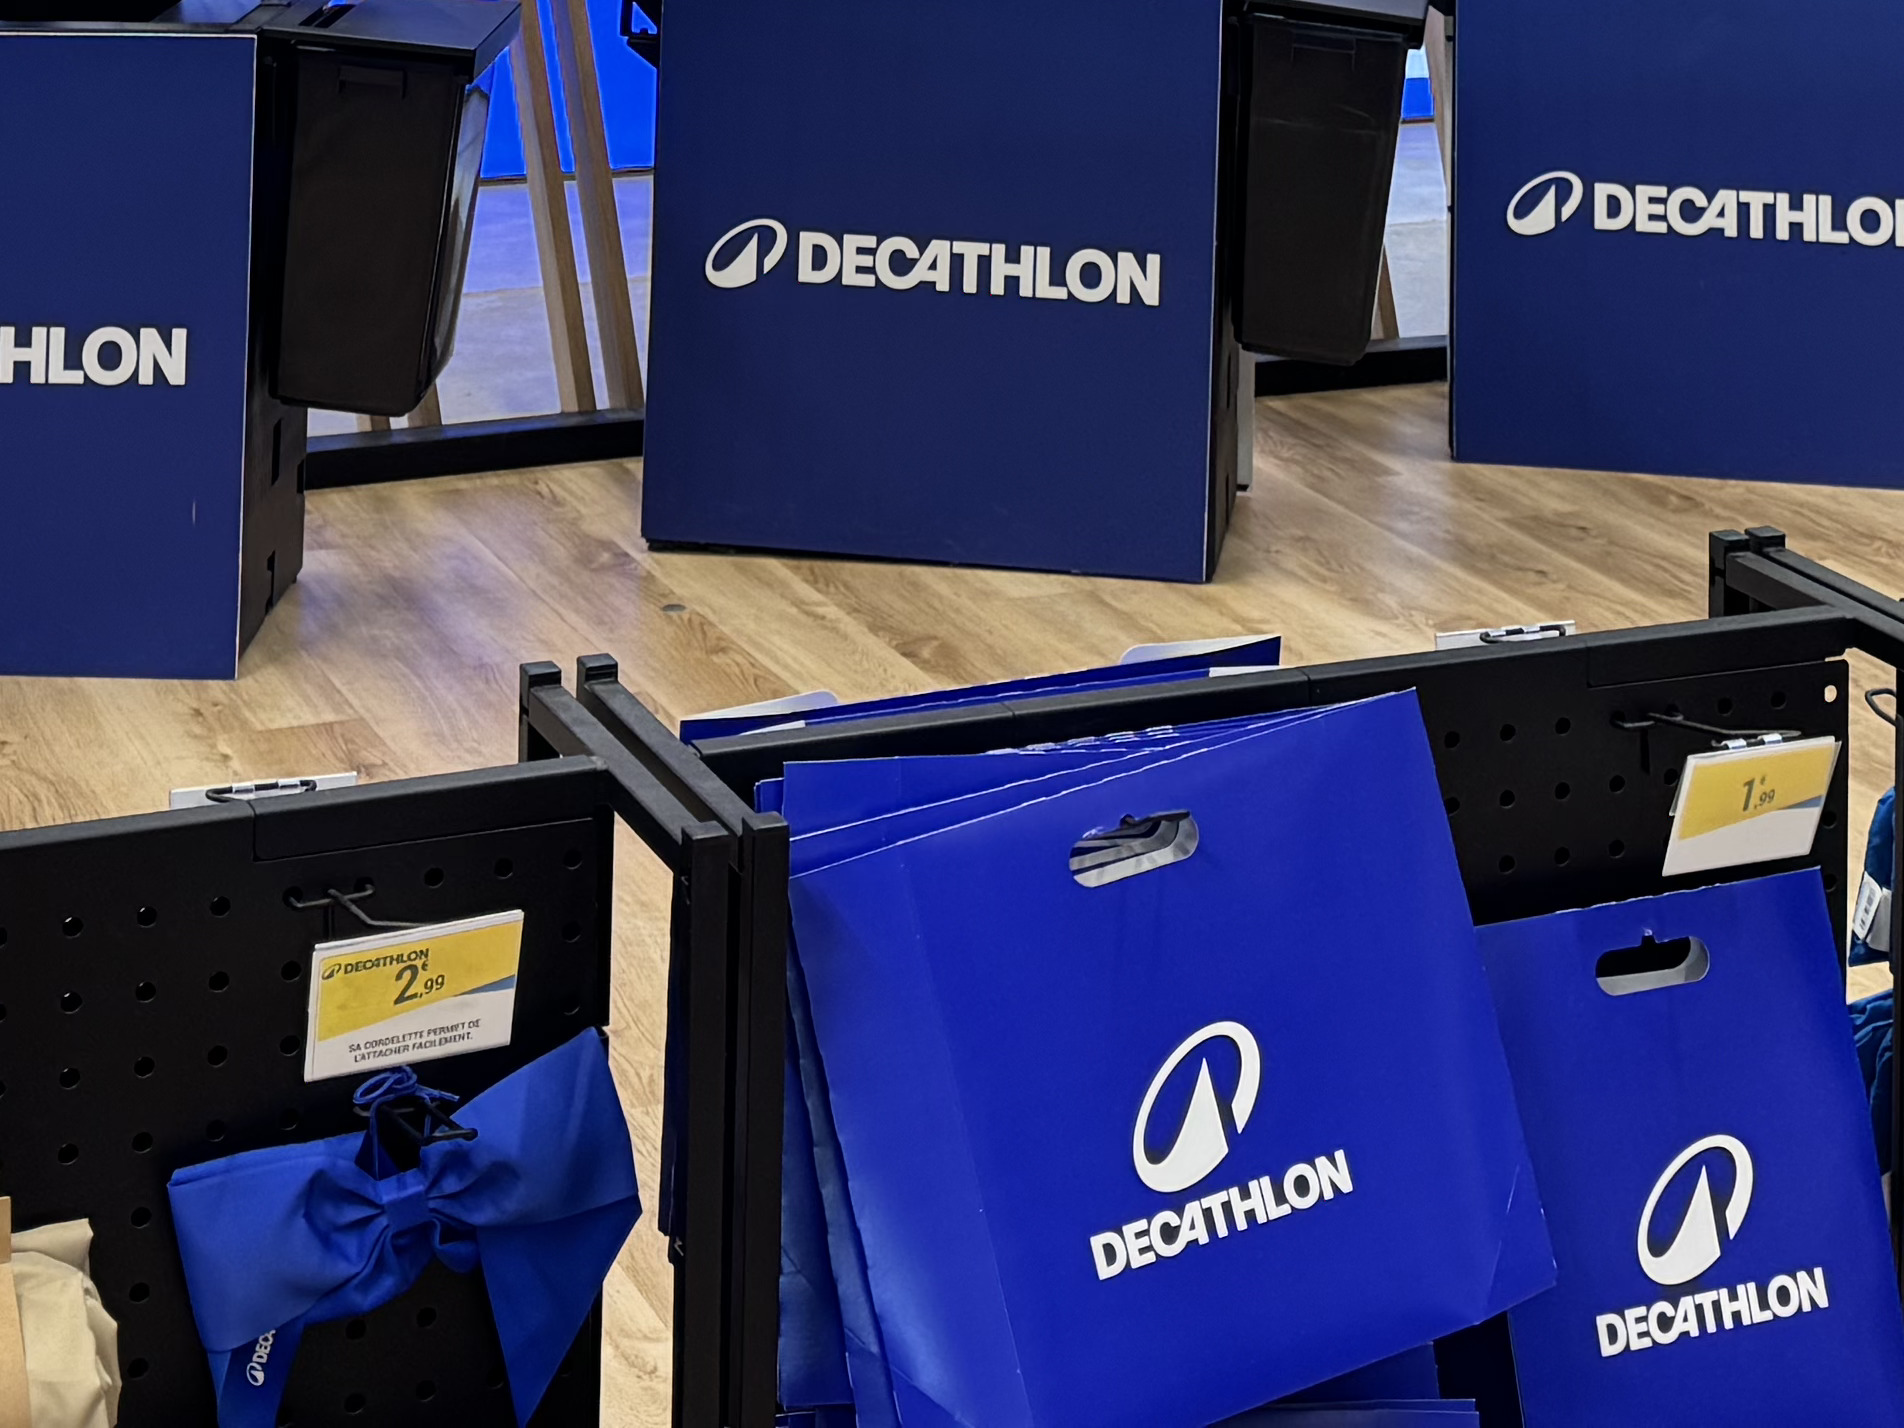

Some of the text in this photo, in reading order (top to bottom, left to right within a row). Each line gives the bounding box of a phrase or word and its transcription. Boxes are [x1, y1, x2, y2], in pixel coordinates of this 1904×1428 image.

[797, 231, 1161, 306] DECATHLON
[343, 947, 430, 975] DECATHLON
[348, 1018, 482, 1054] SA CORDELETTE PERMET DE
[1089, 1148, 1354, 1281] DECATHLON
[1595, 1266, 1830, 1357] DECATHLON
